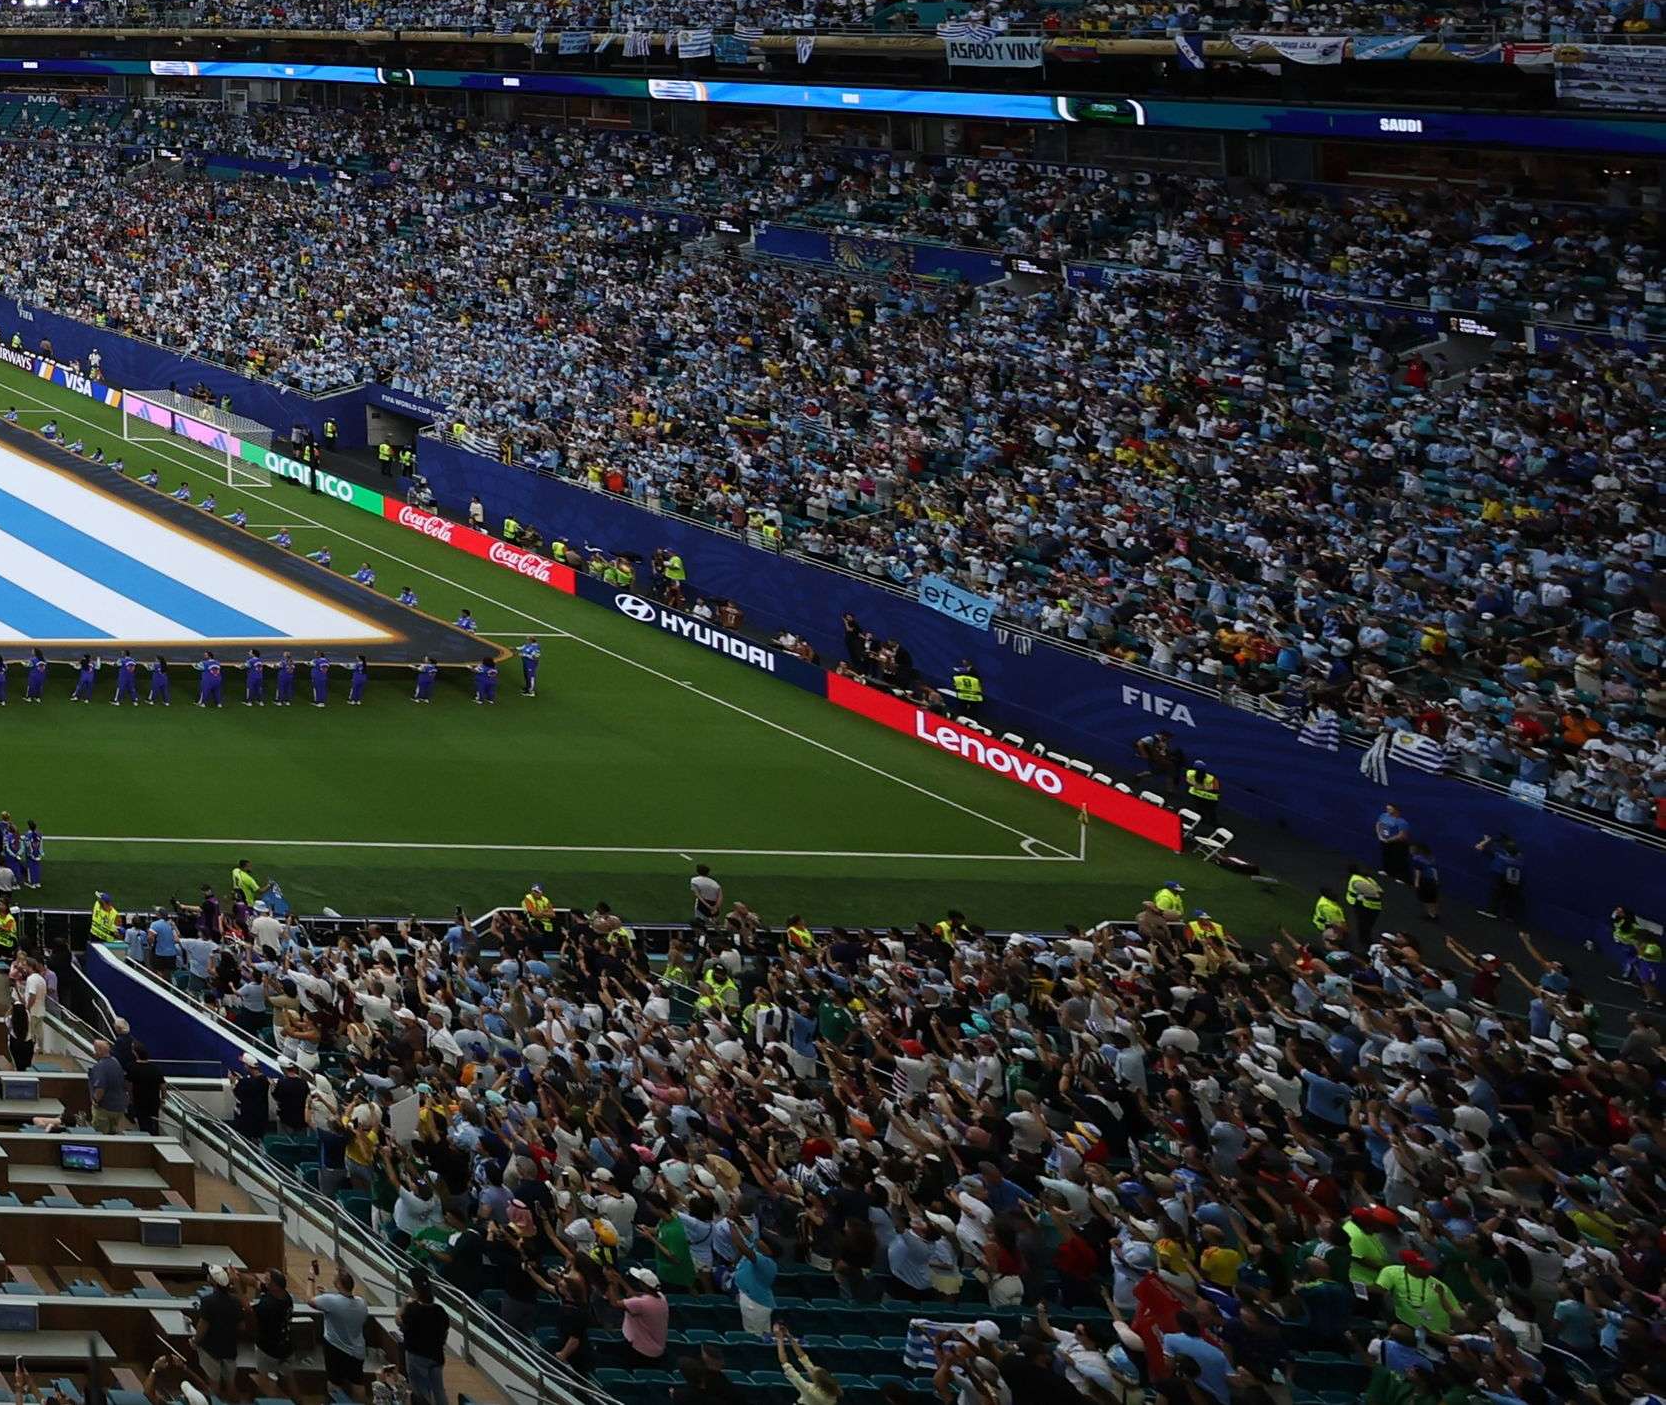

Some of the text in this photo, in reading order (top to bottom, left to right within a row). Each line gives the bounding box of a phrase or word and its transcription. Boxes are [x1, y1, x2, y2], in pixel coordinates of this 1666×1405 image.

[950, 42, 992, 60] ASADO
[993, 43, 1003, 60] Y
[27, 95, 59, 104] MIA
[1379, 117, 1424, 134] SAUDI
[19, 310, 34, 322] FIFA
[64, 371, 93, 397] VISA
[265, 451, 353, 503] aramco
[399, 505, 452, 543] Coca-Cola
[488, 541, 553, 582] Coca-Cola
[924, 586, 990, 623] etxe
[660, 611, 775, 672] HYUNDAI
[1122, 684, 1196, 728] FIFA
[915, 710, 1064, 794] Lenovo
